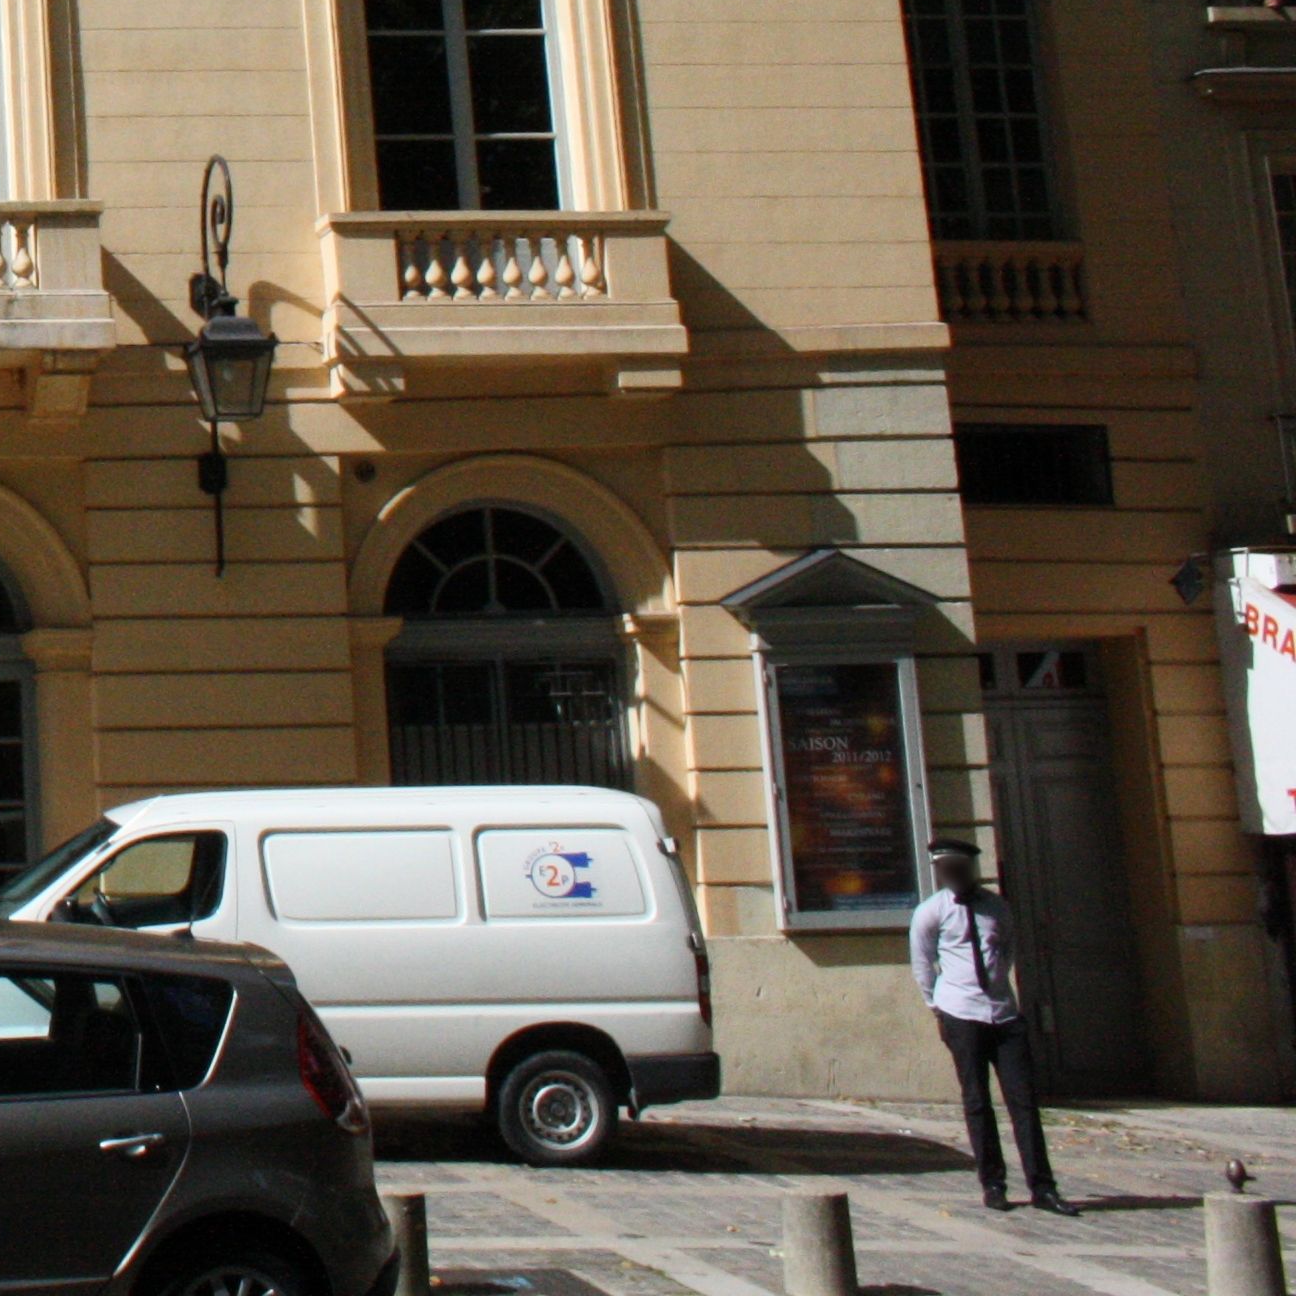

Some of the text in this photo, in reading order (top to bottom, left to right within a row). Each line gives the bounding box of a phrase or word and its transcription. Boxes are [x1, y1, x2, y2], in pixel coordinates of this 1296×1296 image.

[1246, 602, 1296, 662] BRA
[790, 736, 849, 751] SAISON
[831, 750, 892, 763] 2011/2012
